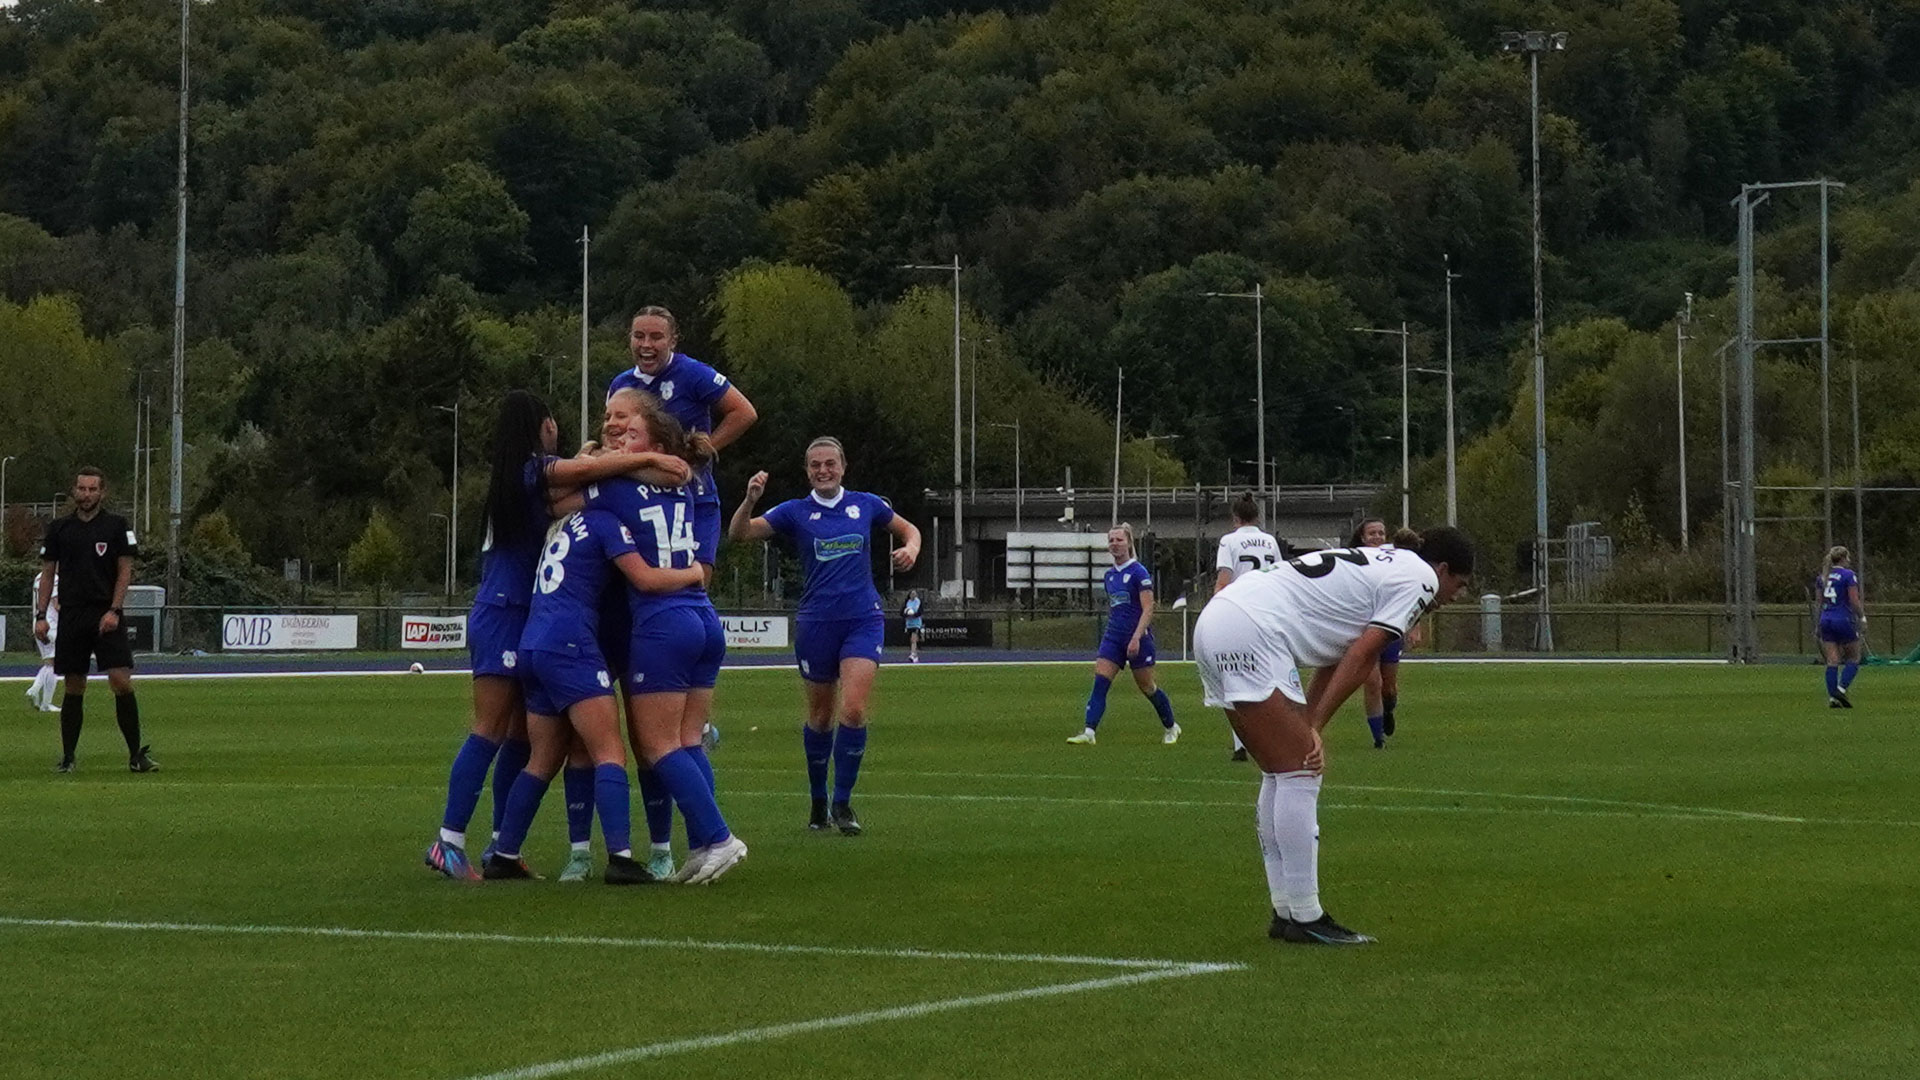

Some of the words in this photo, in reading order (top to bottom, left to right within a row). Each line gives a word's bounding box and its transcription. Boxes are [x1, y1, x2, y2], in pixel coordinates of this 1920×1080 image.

[639, 502, 696, 568] 14
[1240, 539, 1272, 549] DAVIES
[1823, 581, 1837, 604] 4
[281, 617, 330, 629] ENGINEERING
[224, 616, 272, 646] CMB
[407, 624, 427, 639] IAP
[1215, 652, 1257, 663] TRAVEL
[1216, 662, 1259, 672] HOUSE
